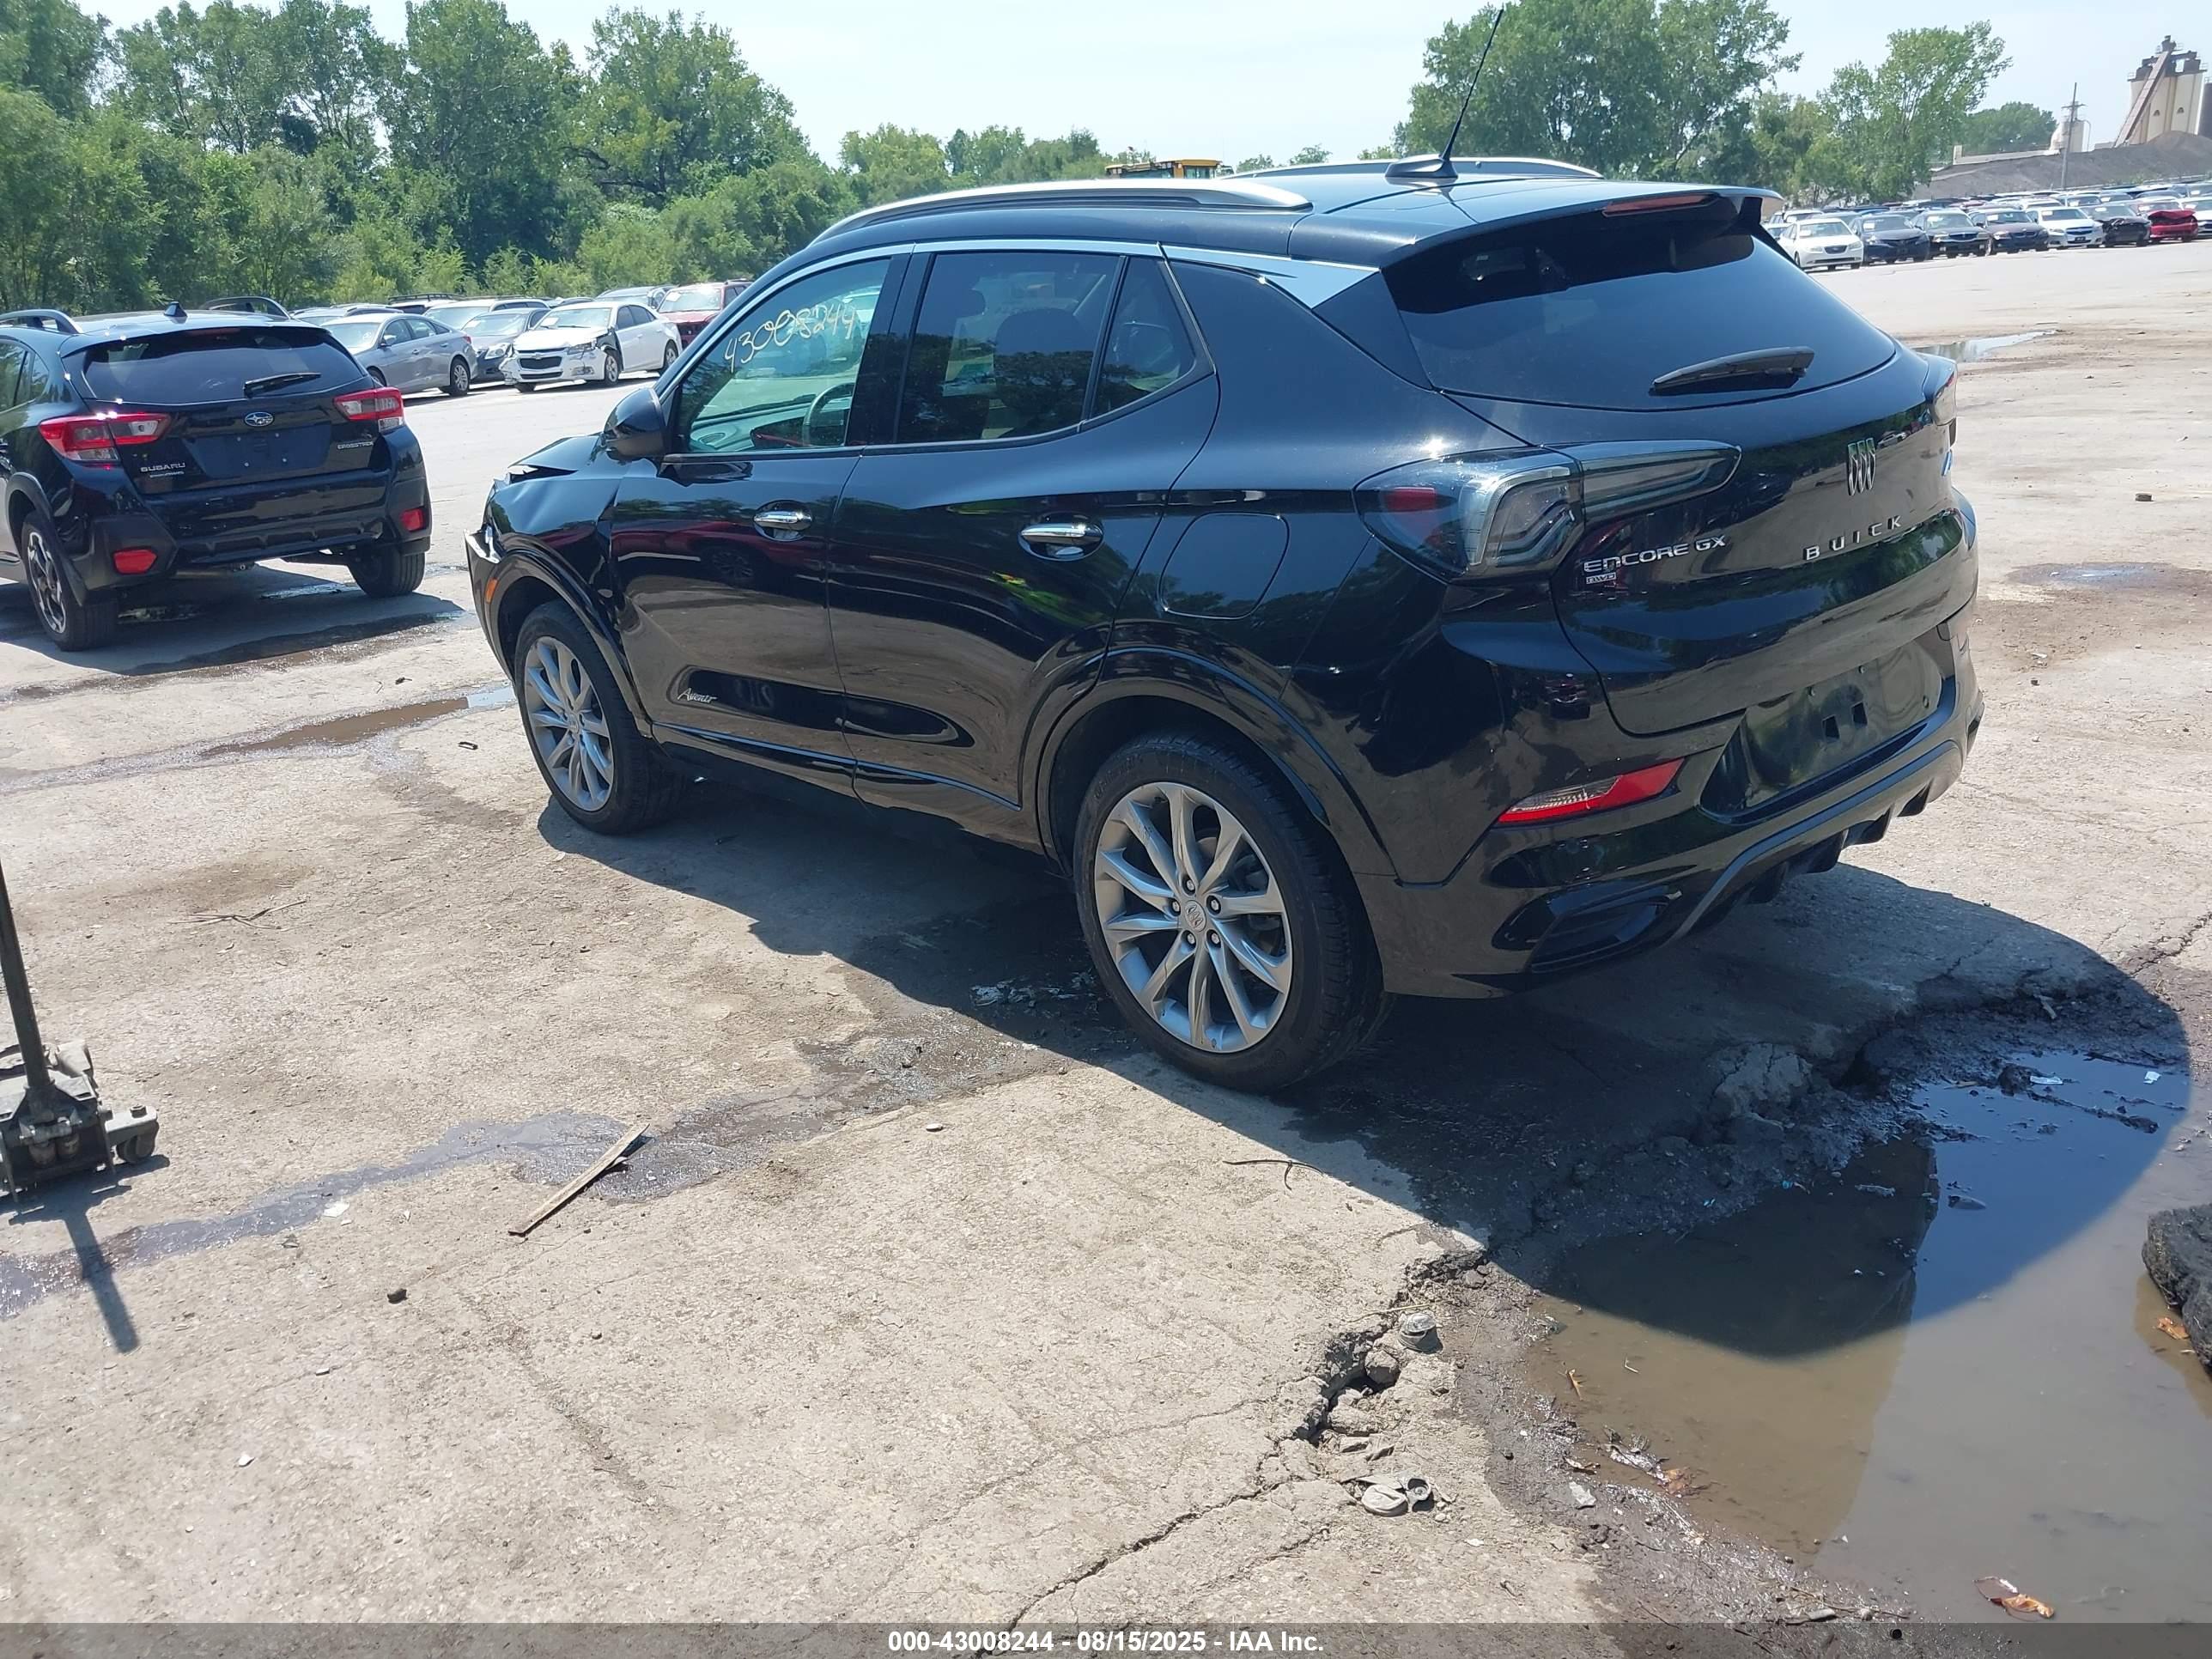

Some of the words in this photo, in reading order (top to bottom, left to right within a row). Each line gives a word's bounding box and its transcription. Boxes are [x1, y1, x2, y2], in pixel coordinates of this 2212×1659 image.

[140, 462, 185, 472] SUBARU
[1583, 543, 1690, 573] ENCORE
[1695, 535, 1726, 551] GX
[1804, 515, 1902, 561] BUICK
